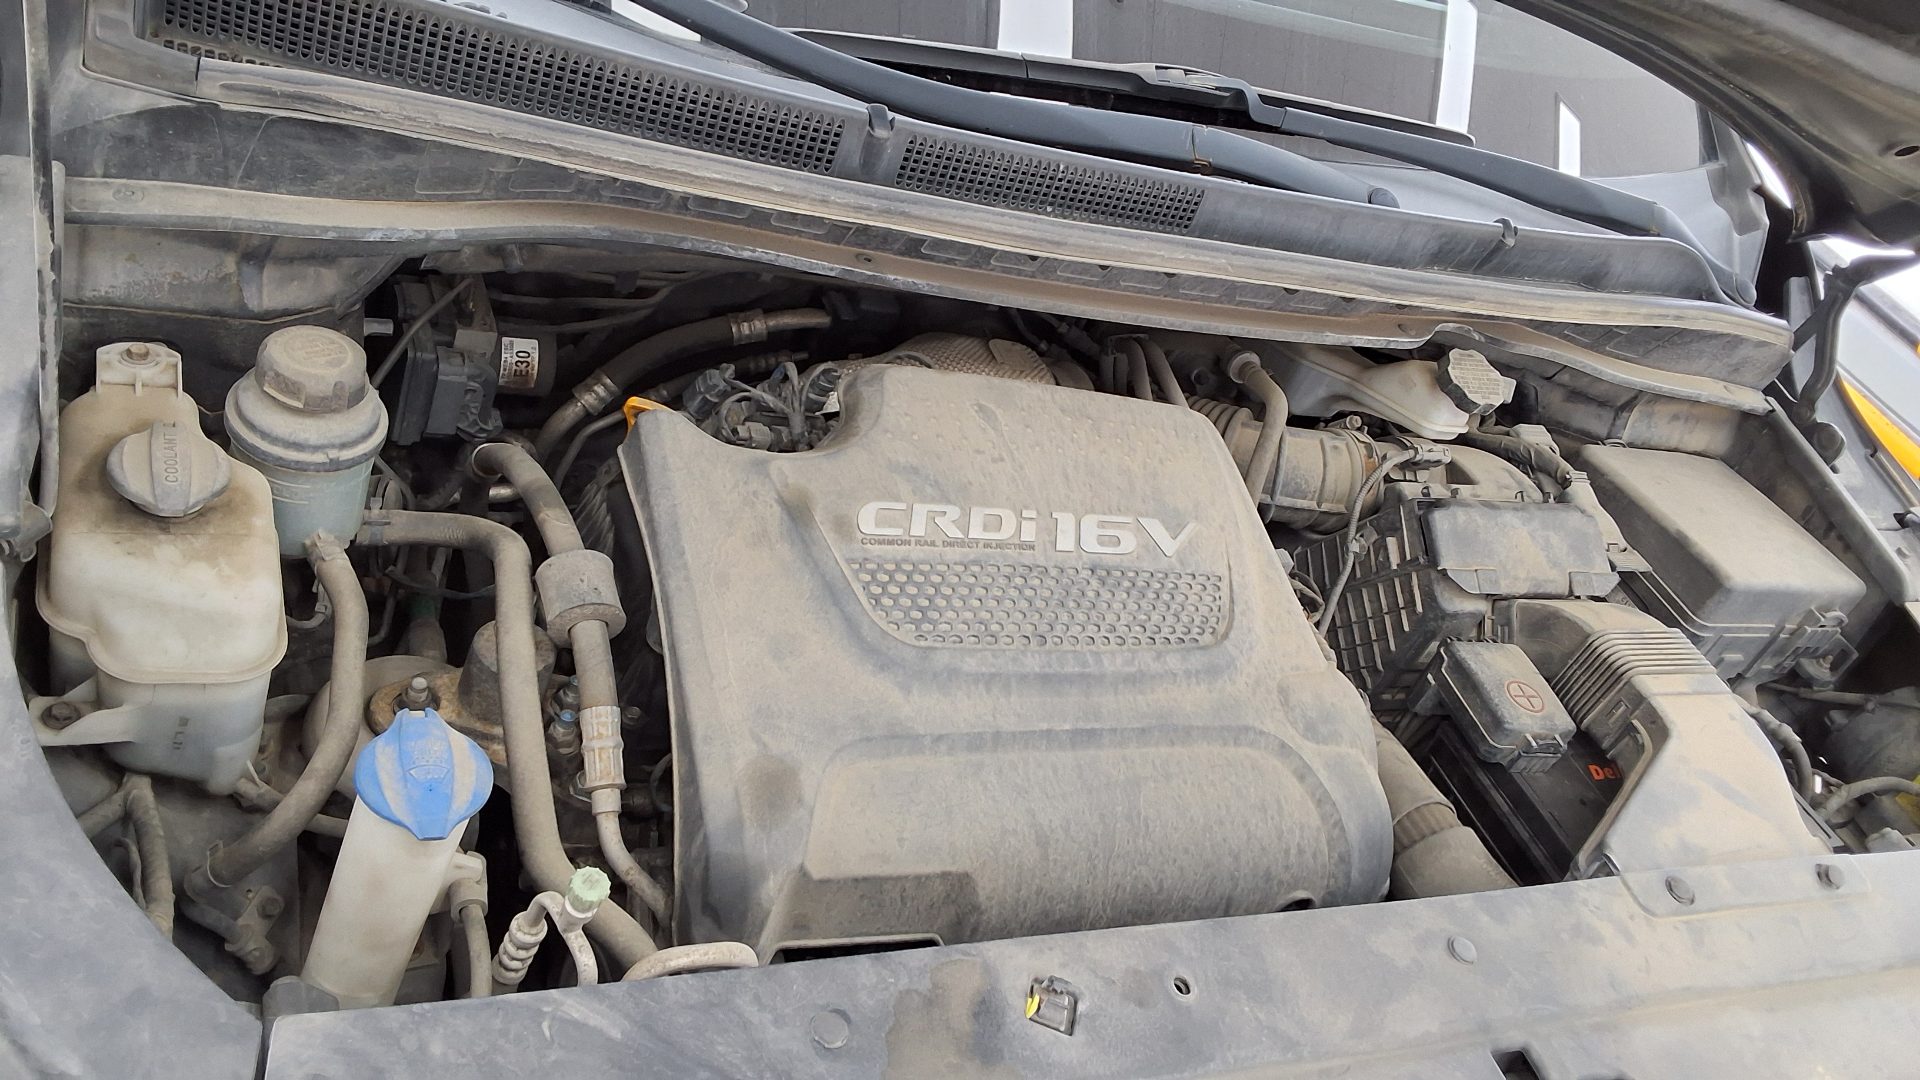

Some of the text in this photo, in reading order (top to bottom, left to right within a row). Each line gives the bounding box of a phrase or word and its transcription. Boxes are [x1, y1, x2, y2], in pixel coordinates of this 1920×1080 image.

[514, 351, 531, 376] E30
[164, 432, 179, 482] COOLANT
[857, 501, 1198, 557] CRDi 16V
[861, 537, 1036, 551] COMMON RAIL DIRECT INJECTION
